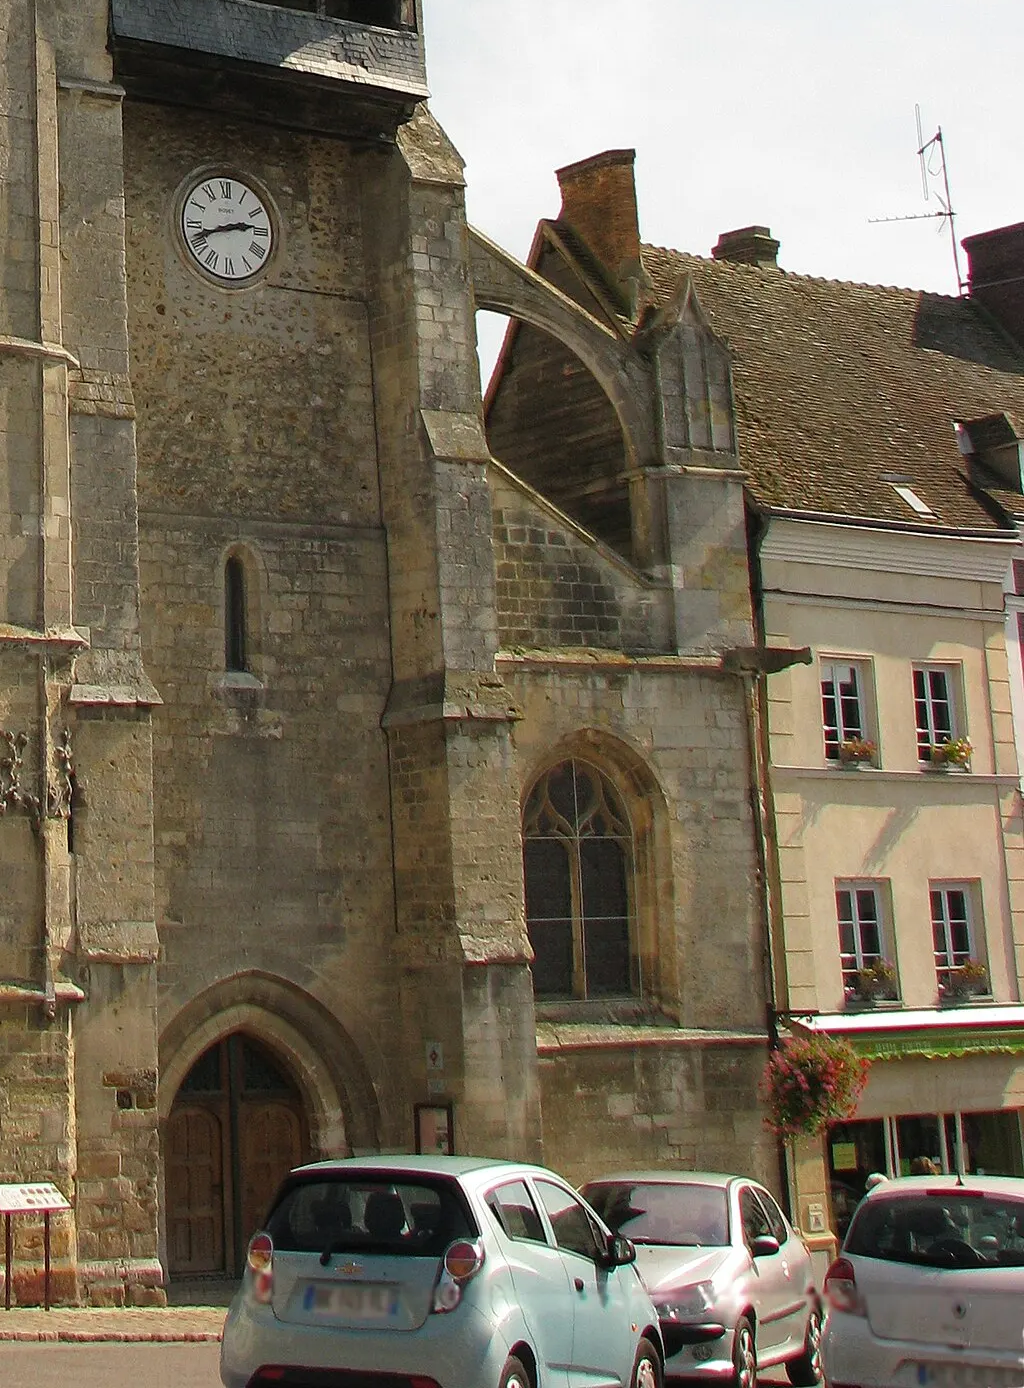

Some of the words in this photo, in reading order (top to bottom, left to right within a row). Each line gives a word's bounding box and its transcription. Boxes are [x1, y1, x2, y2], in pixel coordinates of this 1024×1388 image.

[202, 184, 217, 202] XI
[219, 181, 232, 199] XII
[238, 189, 247, 205] I
[190, 198, 206, 213] X
[248, 206, 263, 219] II
[253, 226, 268, 237] III
[204, 249, 219, 270] VII
[225, 257, 235, 275] VI
[242, 255, 253, 272] V
